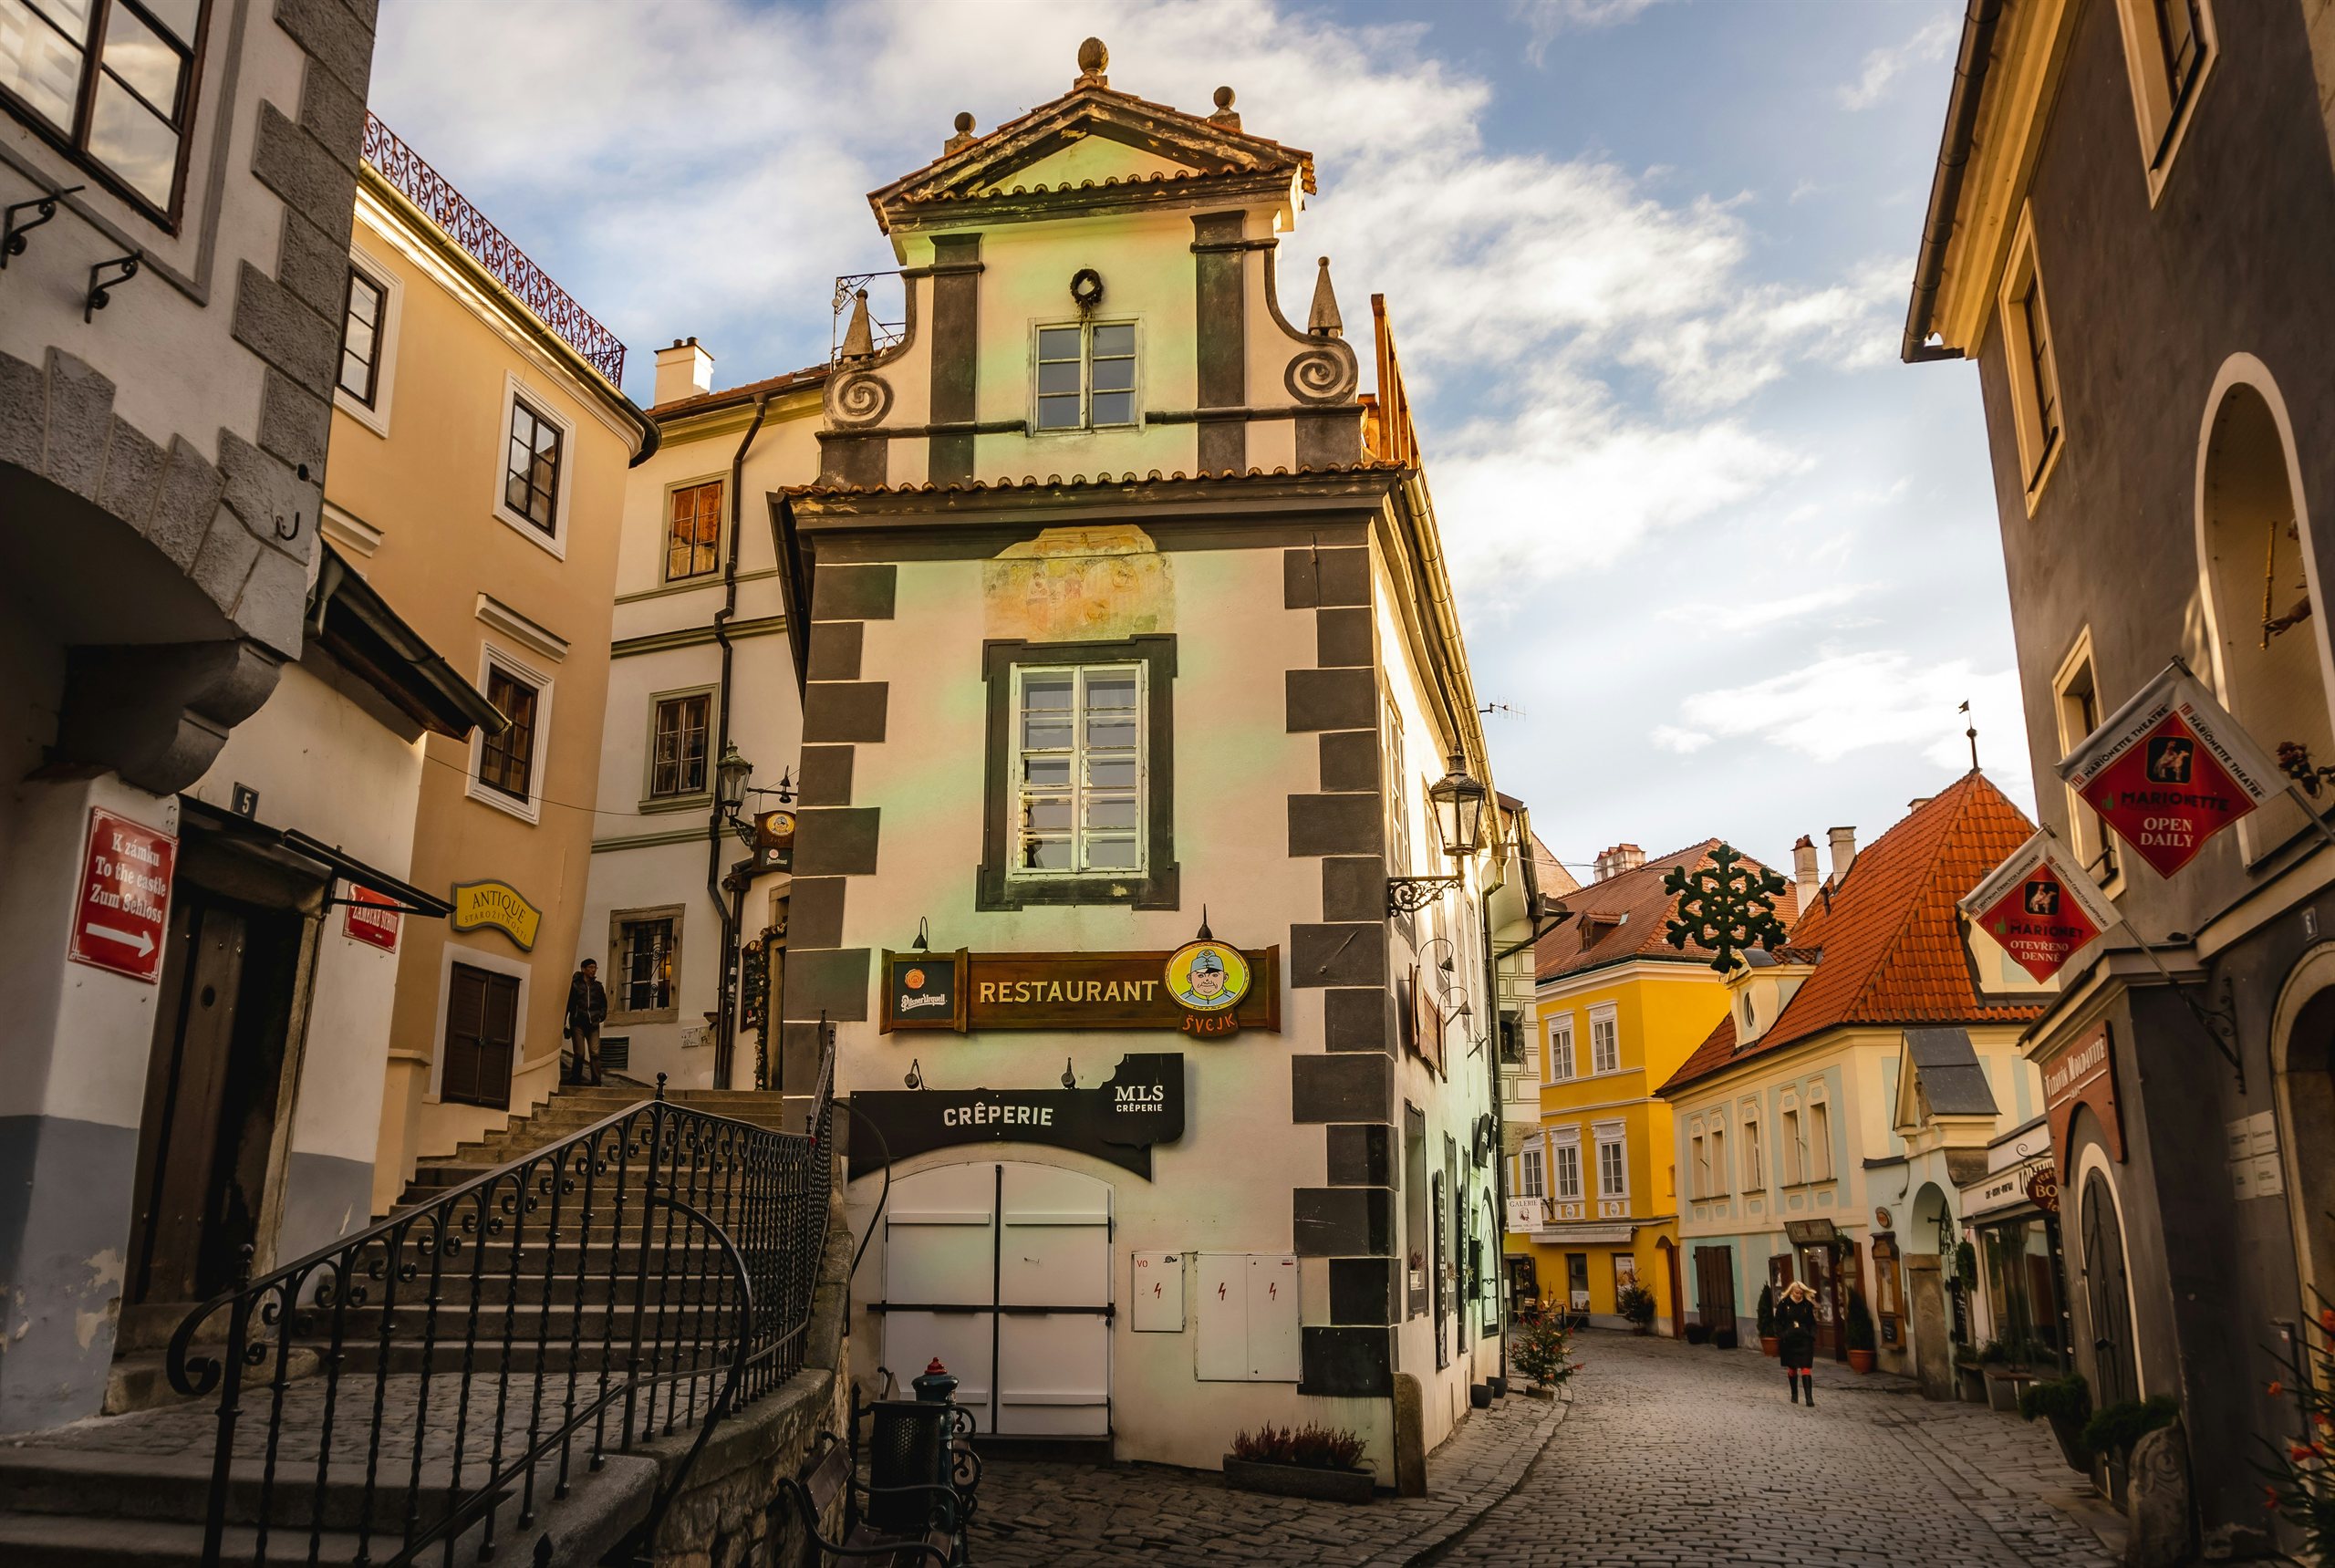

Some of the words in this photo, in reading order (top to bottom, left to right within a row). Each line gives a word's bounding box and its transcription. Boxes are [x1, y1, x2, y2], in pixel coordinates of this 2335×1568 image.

[2084, 736, 2133, 778] MARIONETTE
[2131, 706, 2169, 738] THEATRE
[2188, 716, 2233, 763] MARIONETTE
[2229, 762, 2263, 798] THEATRE
[243, 792, 252, 814] 5
[2122, 792, 2230, 812] MARIONETTE
[2143, 817, 2193, 832] OPEN
[111, 832, 122, 852] K
[125, 839, 160, 867] zámku
[2140, 832, 2194, 847] DAILY
[95, 855, 112, 877] To
[115, 862, 134, 884] the
[137, 874, 166, 898] castle
[89, 883, 119, 909] Zum
[122, 893, 162, 924] Schloss
[472, 890, 526, 924] ANTIQUE
[2010, 940, 2069, 951] OTEVŘENO
[980, 980, 1158, 1003] RESTAURANT
[1182, 1013, 1236, 1033] ŠVEJK
[1115, 1085, 1164, 1102] MLS
[943, 1102, 1053, 1127] CRÊPERIE
[1116, 1103, 1163, 1113] CRÊPERIE
